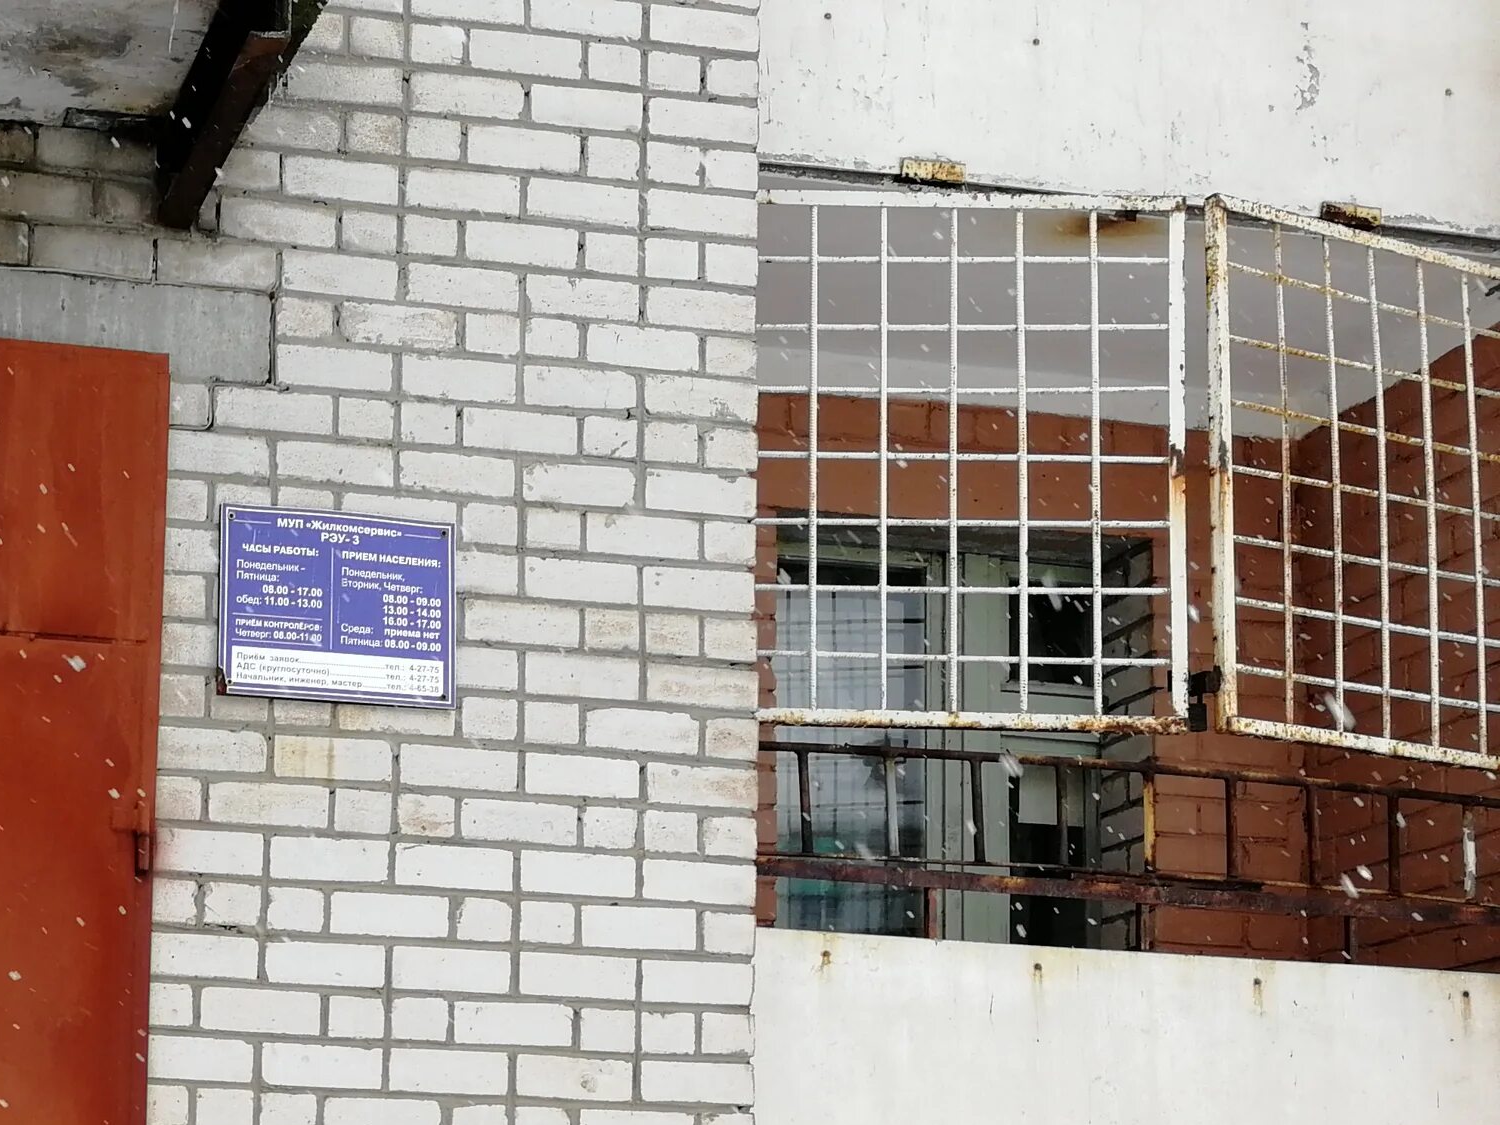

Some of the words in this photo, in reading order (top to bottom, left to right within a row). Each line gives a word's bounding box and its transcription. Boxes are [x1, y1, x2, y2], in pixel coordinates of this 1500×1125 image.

[277, 518, 304, 530] МУП
[306, 520, 402, 537] «Жилкомсервис»
[242, 543, 272, 553] ЧАСЫ
[273, 546, 319, 557] РАБОТЫ:
[236, 559, 300, 572] Понедельник
[342, 551, 377, 562] ПРИЕМ
[379, 555, 441, 568] НАСЕЛЕНИЯ:
[236, 570, 280, 583] Пятница:
[342, 567, 406, 582] Понедельник,
[262, 585, 288, 595] 08.00
[297, 587, 323, 597] 17.00
[341, 578, 382, 591] Вторник,
[384, 581, 424, 595] Четверг:
[236, 595, 262, 605] обед:
[264, 596, 290, 606] 11.00
[297, 599, 323, 608] 13.00
[383, 594, 408, 604] 08.00
[416, 597, 441, 607] 09.00
[382, 605, 408, 615] 13.00
[416, 608, 441, 618] 14.00
[340, 623, 374, 634] Среда:
[416, 619, 441, 629] 17.00
[235, 628, 272, 638] Четверг:
[340, 635, 383, 648] Пятница:
[384, 639, 410, 649] 08.00
[416, 641, 442, 652] 09.00
[236, 661, 256, 670] АДС
[409, 675, 440, 684] 4-27-75
[409, 665, 440, 674] 4-27-75
